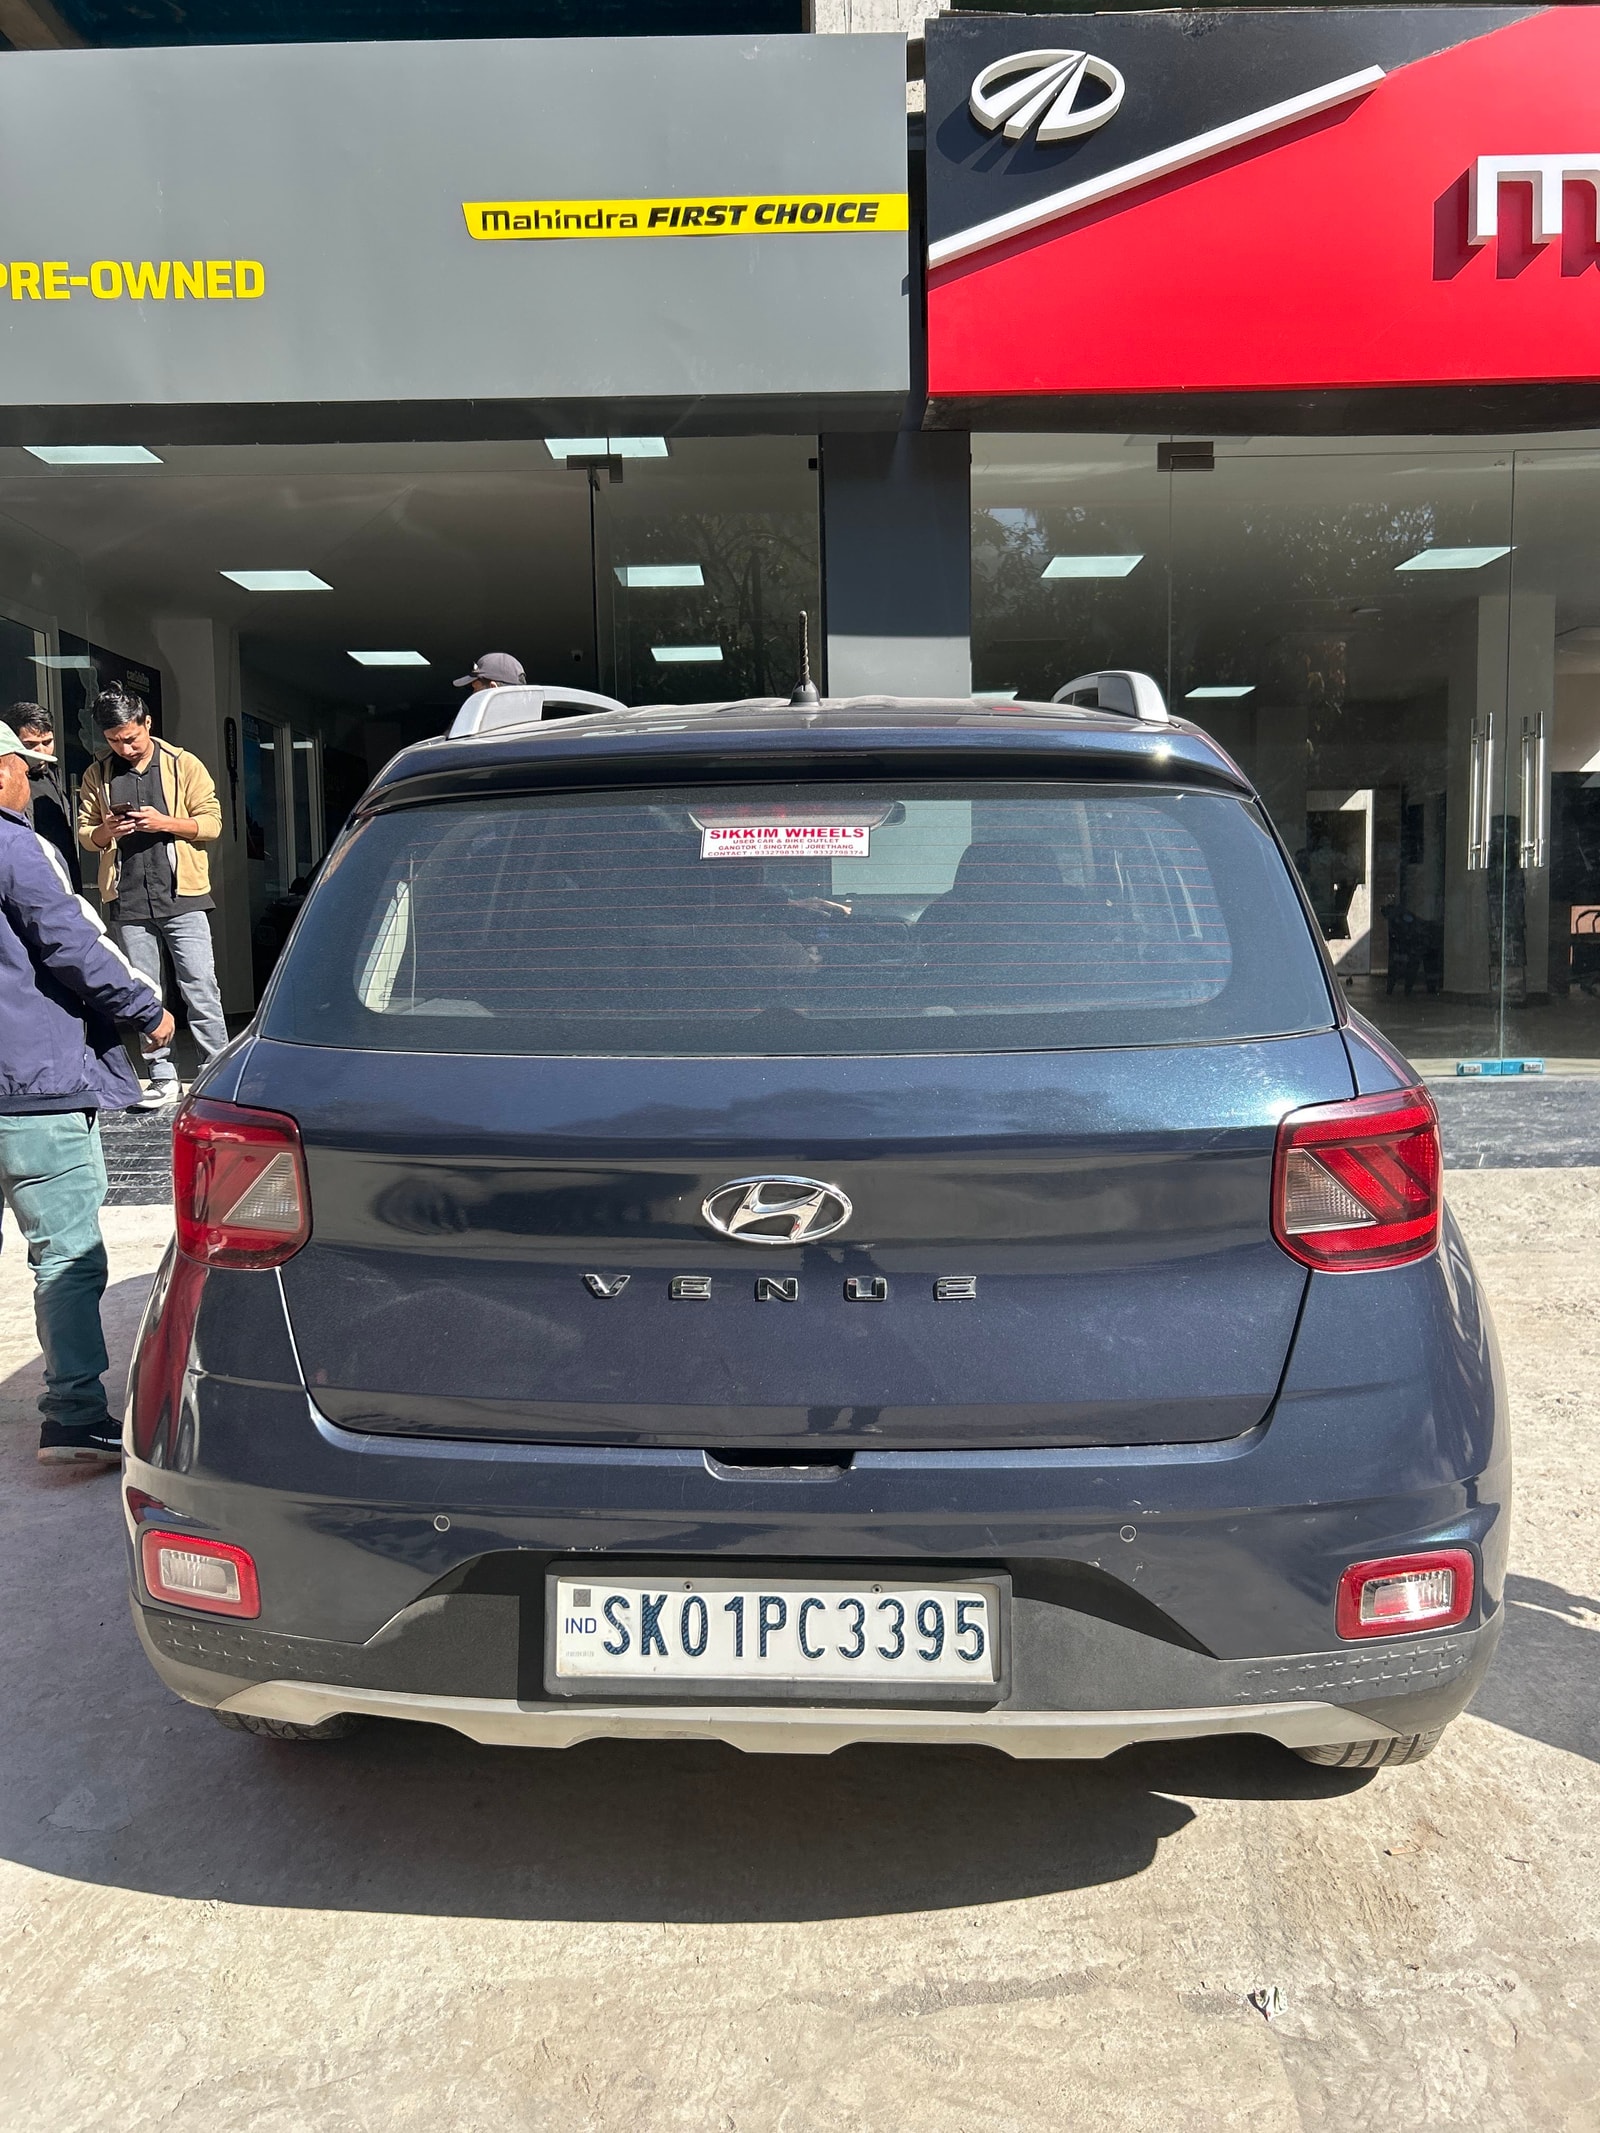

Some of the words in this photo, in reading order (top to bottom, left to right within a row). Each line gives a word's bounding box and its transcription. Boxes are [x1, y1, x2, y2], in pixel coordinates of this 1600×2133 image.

[481, 208, 638, 232] Mahindra
[647, 203, 748, 228] FIRST
[753, 201, 880, 226] CHOICE
[0, 260, 266, 300] RE-OWNED
[709, 828, 779, 840] SIKKIM
[785, 827, 865, 839] WHEELS
[581, 1273, 978, 1301] VENUE
[565, 1617, 597, 1634] IND
[601, 1593, 986, 1663] SK01PC3395
